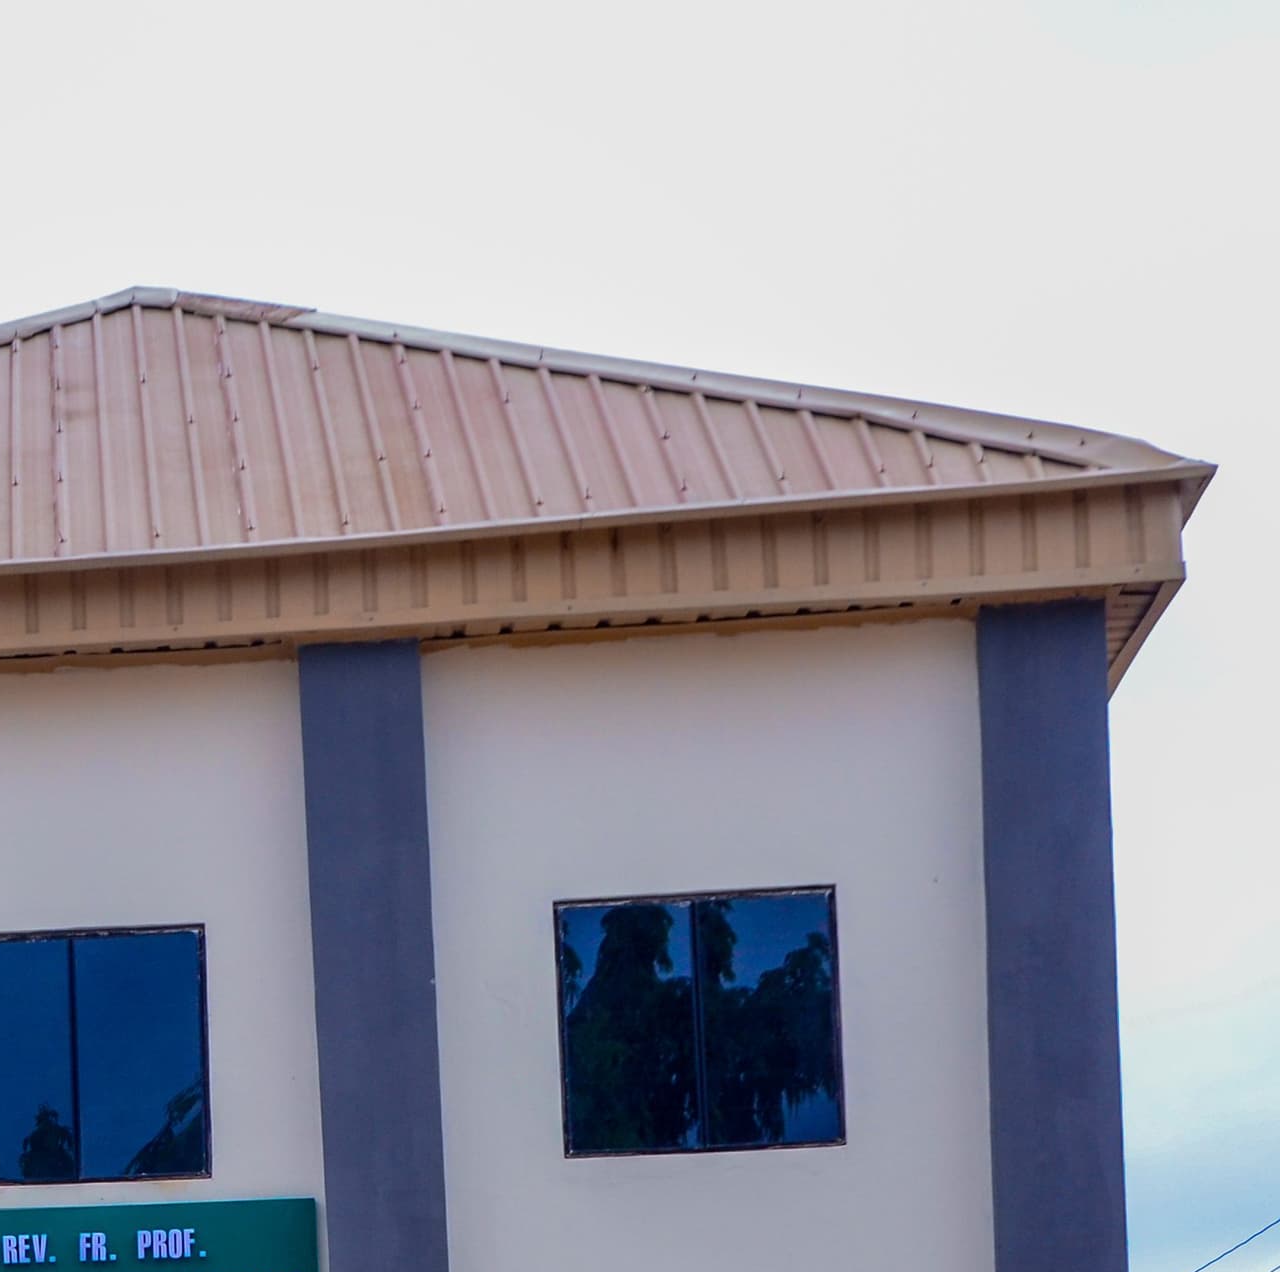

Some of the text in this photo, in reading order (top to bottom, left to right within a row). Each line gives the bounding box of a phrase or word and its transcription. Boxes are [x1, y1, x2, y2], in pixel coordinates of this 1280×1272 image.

[2, 1228, 206, 1264] REV. FR. PROF.
